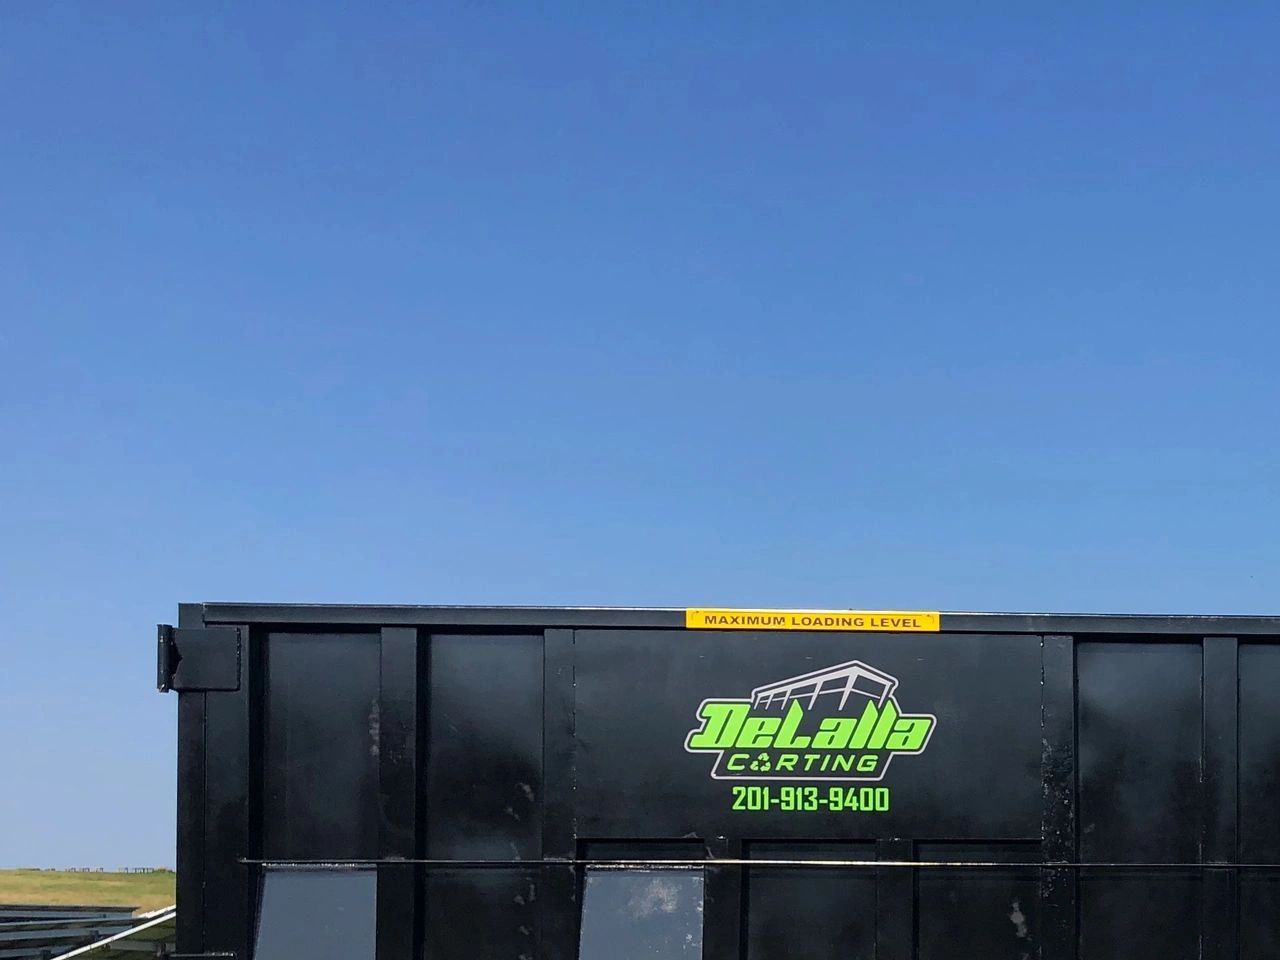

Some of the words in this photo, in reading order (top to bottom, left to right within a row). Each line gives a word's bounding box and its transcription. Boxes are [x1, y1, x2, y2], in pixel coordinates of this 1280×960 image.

[704, 615, 786, 627] MAXIMUM
[791, 616, 865, 628] LOADING
[870, 617, 921, 628] LEVEL
[690, 699, 932, 749] DeLalla
[732, 786, 889, 812] 201-913-9400
